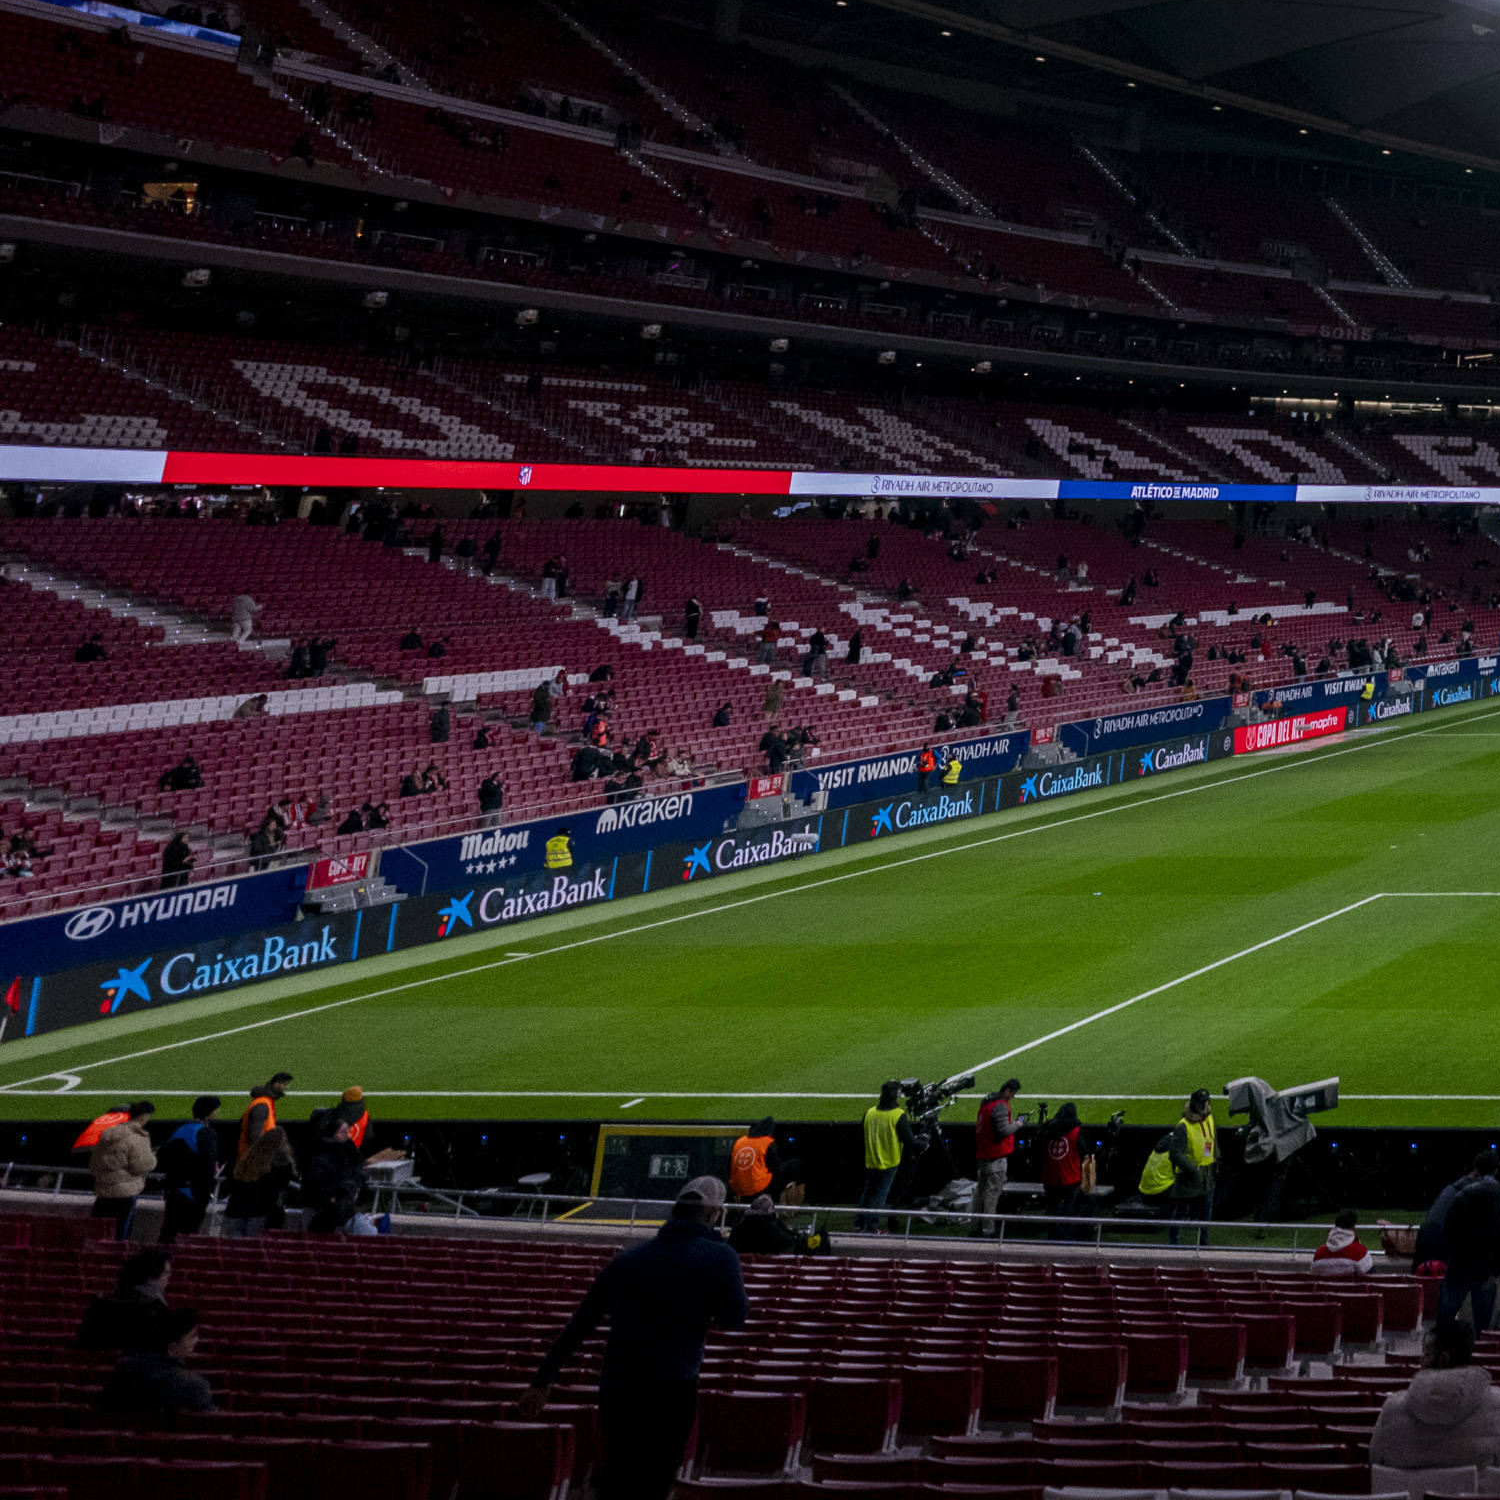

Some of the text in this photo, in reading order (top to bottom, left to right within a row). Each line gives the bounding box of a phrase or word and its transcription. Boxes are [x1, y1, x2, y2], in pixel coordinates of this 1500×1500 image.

[882, 479, 994, 493] RIYADH AIR METROPOLITANO
[1130, 483, 1173, 499] ATLÉTICO
[1181, 487, 1219, 499] MADRID
[1300, 686, 1312, 698] AIR
[1324, 680, 1343, 695] VISIT
[1377, 697, 1411, 719] CaixaBank
[1103, 716, 1135, 734] RIYADH
[1136, 714, 1149, 729] AIR
[1256, 724, 1276, 748] COPA
[1278, 720, 1290, 741] DEL
[991, 738, 1010, 755] AIR
[1155, 740, 1205, 770] CaixaBank
[818, 766, 854, 791] VISIT
[1039, 763, 1103, 797] CaixaBank
[896, 790, 973, 829] CaixaBank
[460, 829, 529, 862] Mahou
[119, 884, 238, 929] HYUNDAI
[480, 868, 607, 923] CaixaBank
[161, 925, 337, 995] CaixaBank
